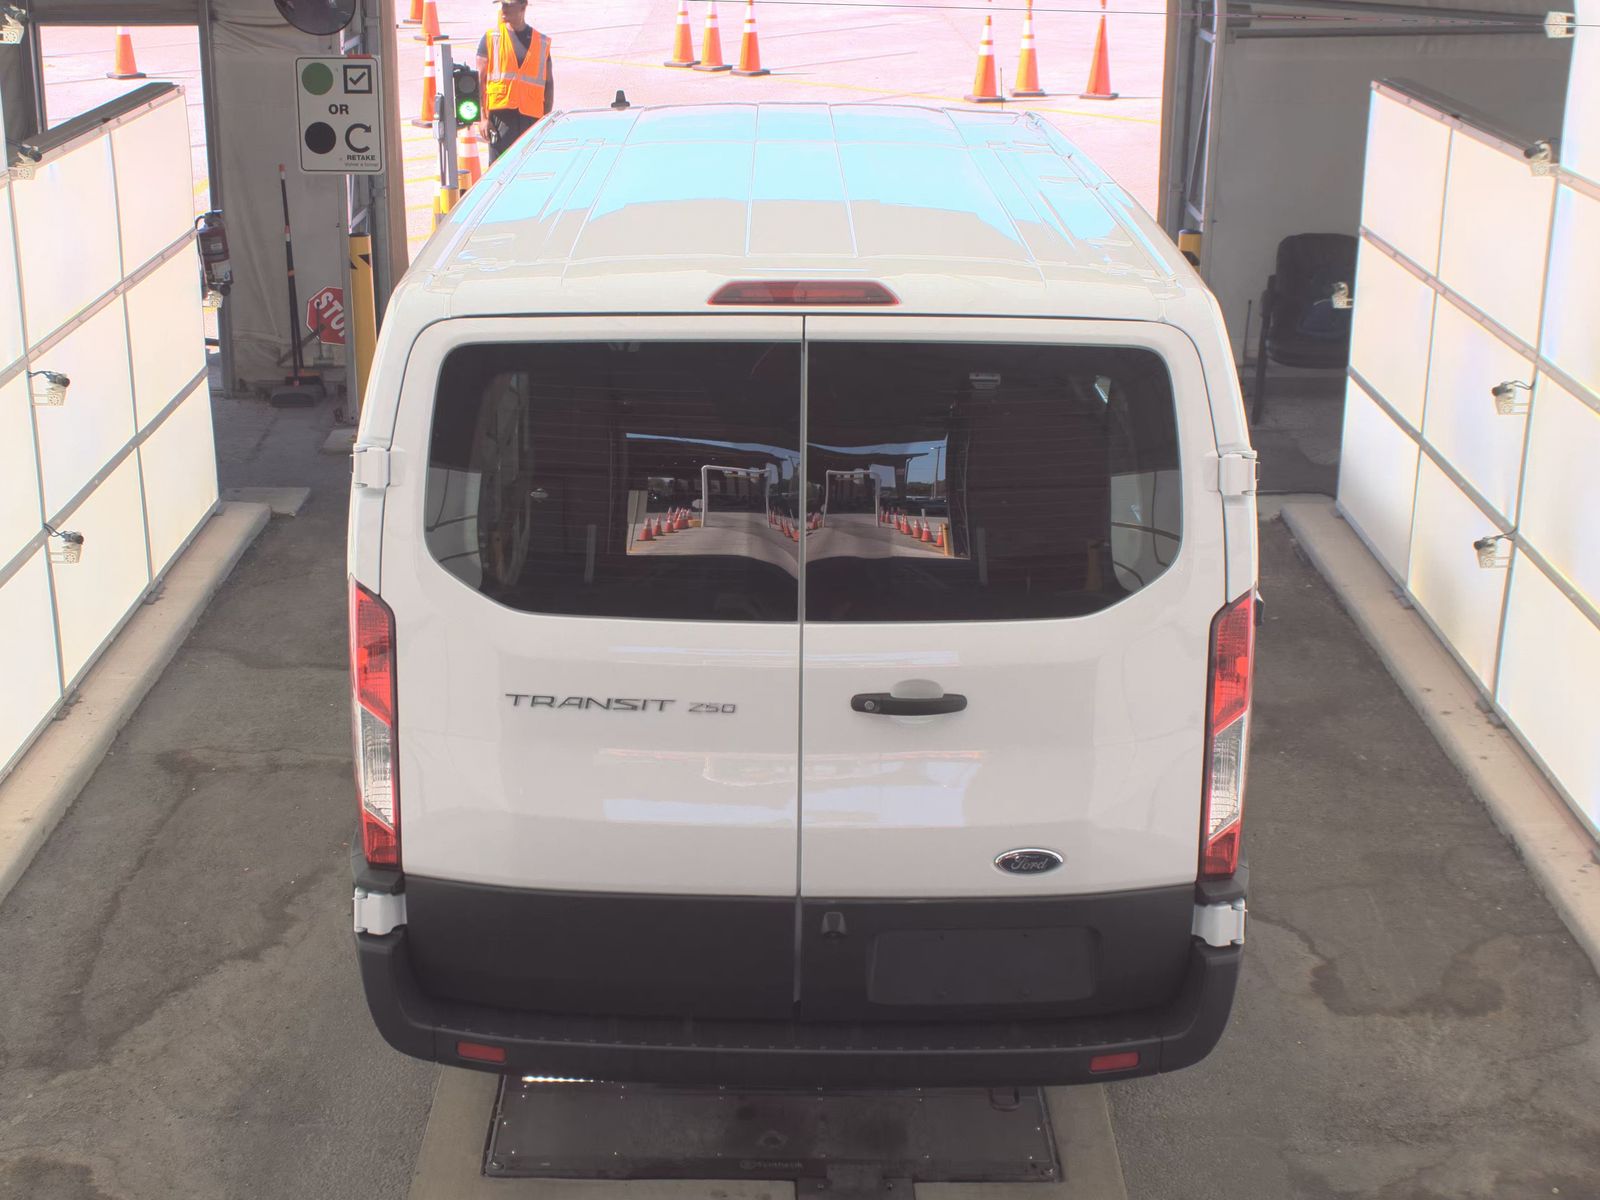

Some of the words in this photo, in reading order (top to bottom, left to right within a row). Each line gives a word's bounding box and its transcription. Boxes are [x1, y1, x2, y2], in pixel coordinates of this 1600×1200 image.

[328, 104, 349, 115] OR
[313, 291, 345, 337] STO
[505, 693, 677, 713] TRANSIT
[688, 702, 737, 714] 250
[1010, 856, 1050, 871] Ford
